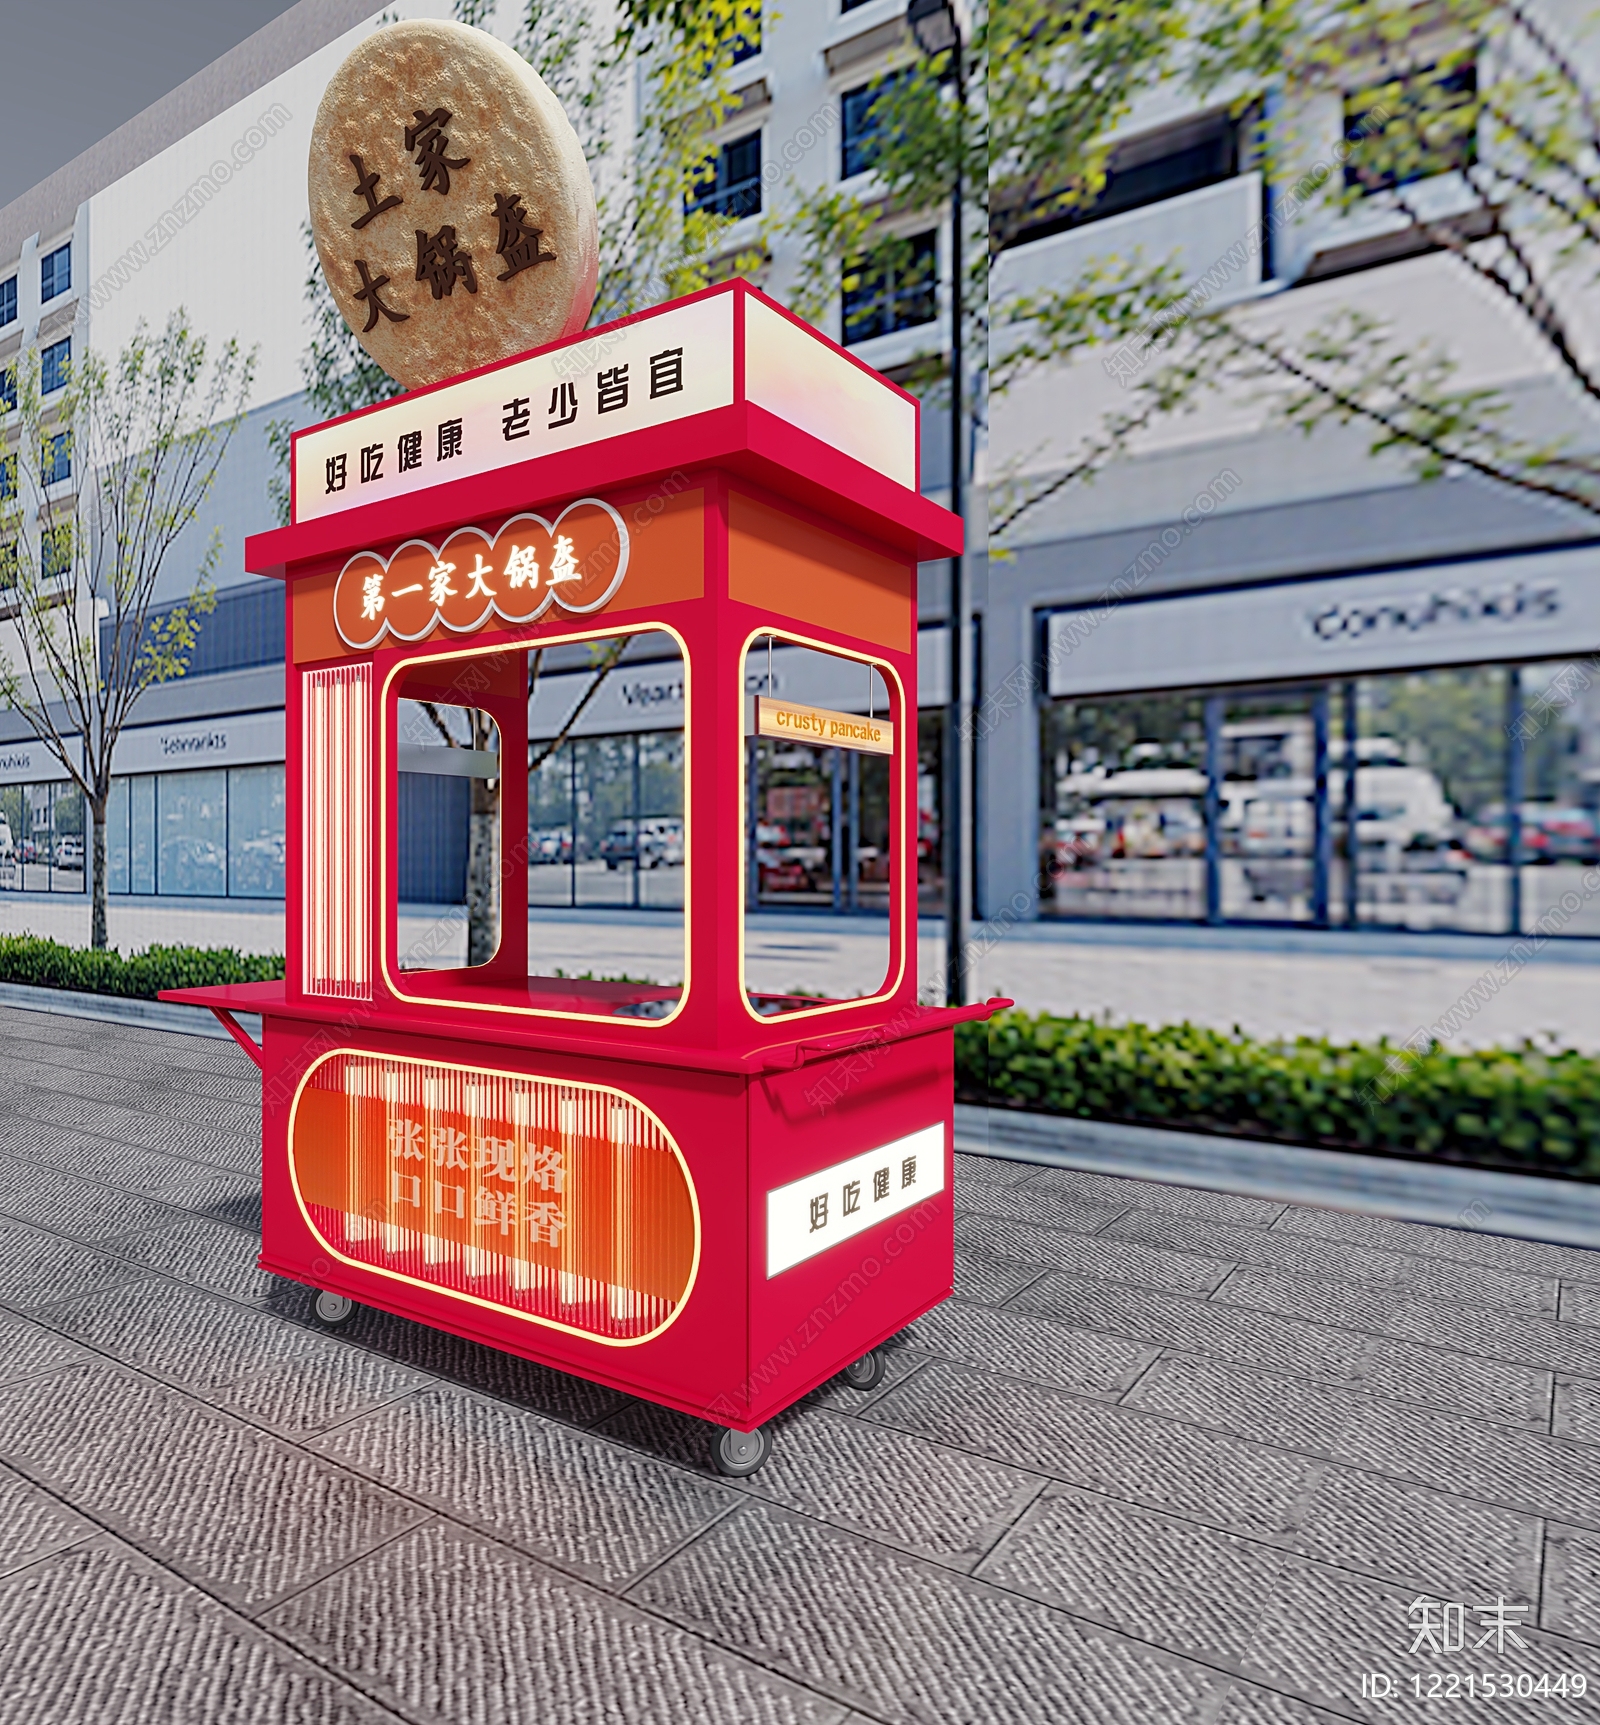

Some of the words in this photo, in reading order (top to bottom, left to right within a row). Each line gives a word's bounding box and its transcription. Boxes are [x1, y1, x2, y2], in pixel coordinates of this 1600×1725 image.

[349, 108, 471, 230] 土家
[353, 193, 557, 332] 大锅盔
[325, 417, 463, 494] 好吃健康
[502, 347, 684, 441] 老少皆宜
[360, 534, 582, 621] 第一家大锅盔
[776, 711, 826, 736] crusty
[830, 721, 881, 742] pancake
[389, 1118, 567, 1193] 张张现烙
[809, 1155, 916, 1234] 好吃健康
[391, 1170, 567, 1248] 口口鲜香
